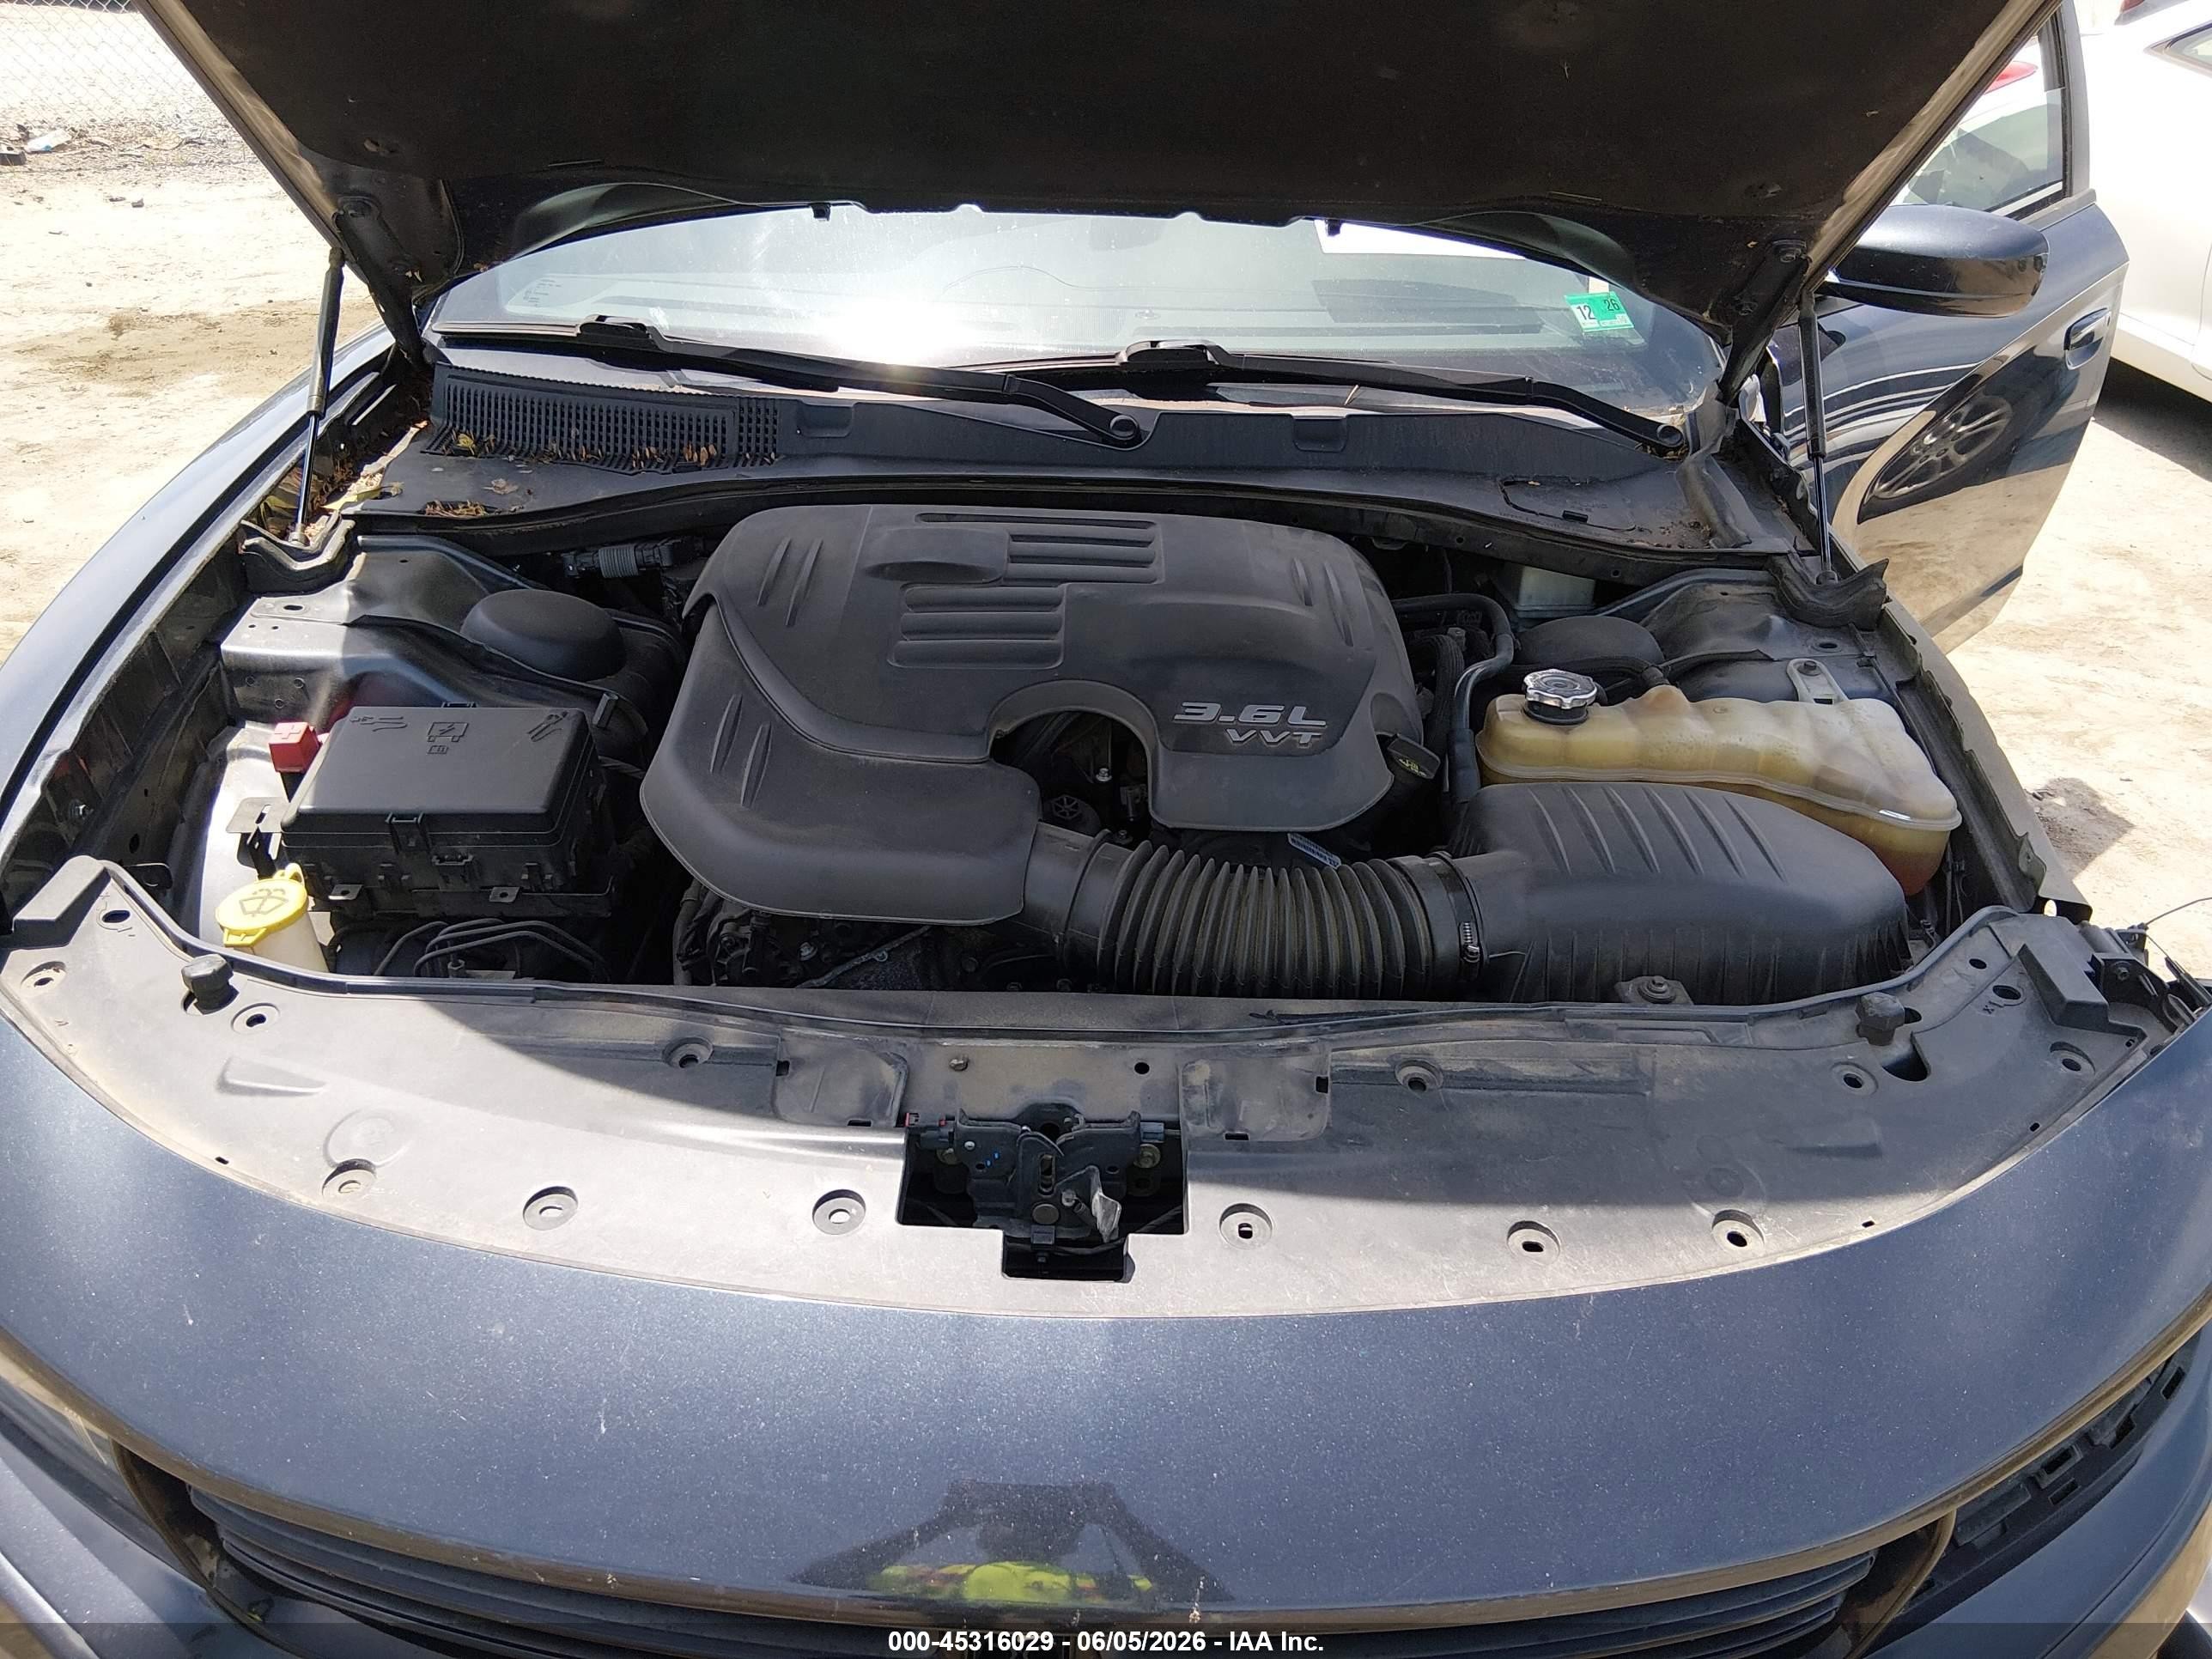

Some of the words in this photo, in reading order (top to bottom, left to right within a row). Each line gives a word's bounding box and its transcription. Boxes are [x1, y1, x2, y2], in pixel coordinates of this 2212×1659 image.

[1576, 305, 1596, 320] 12
[1603, 298, 1620, 312] 26
[1173, 701, 1327, 726] 3.6L
[1225, 728, 1323, 746] VVT
